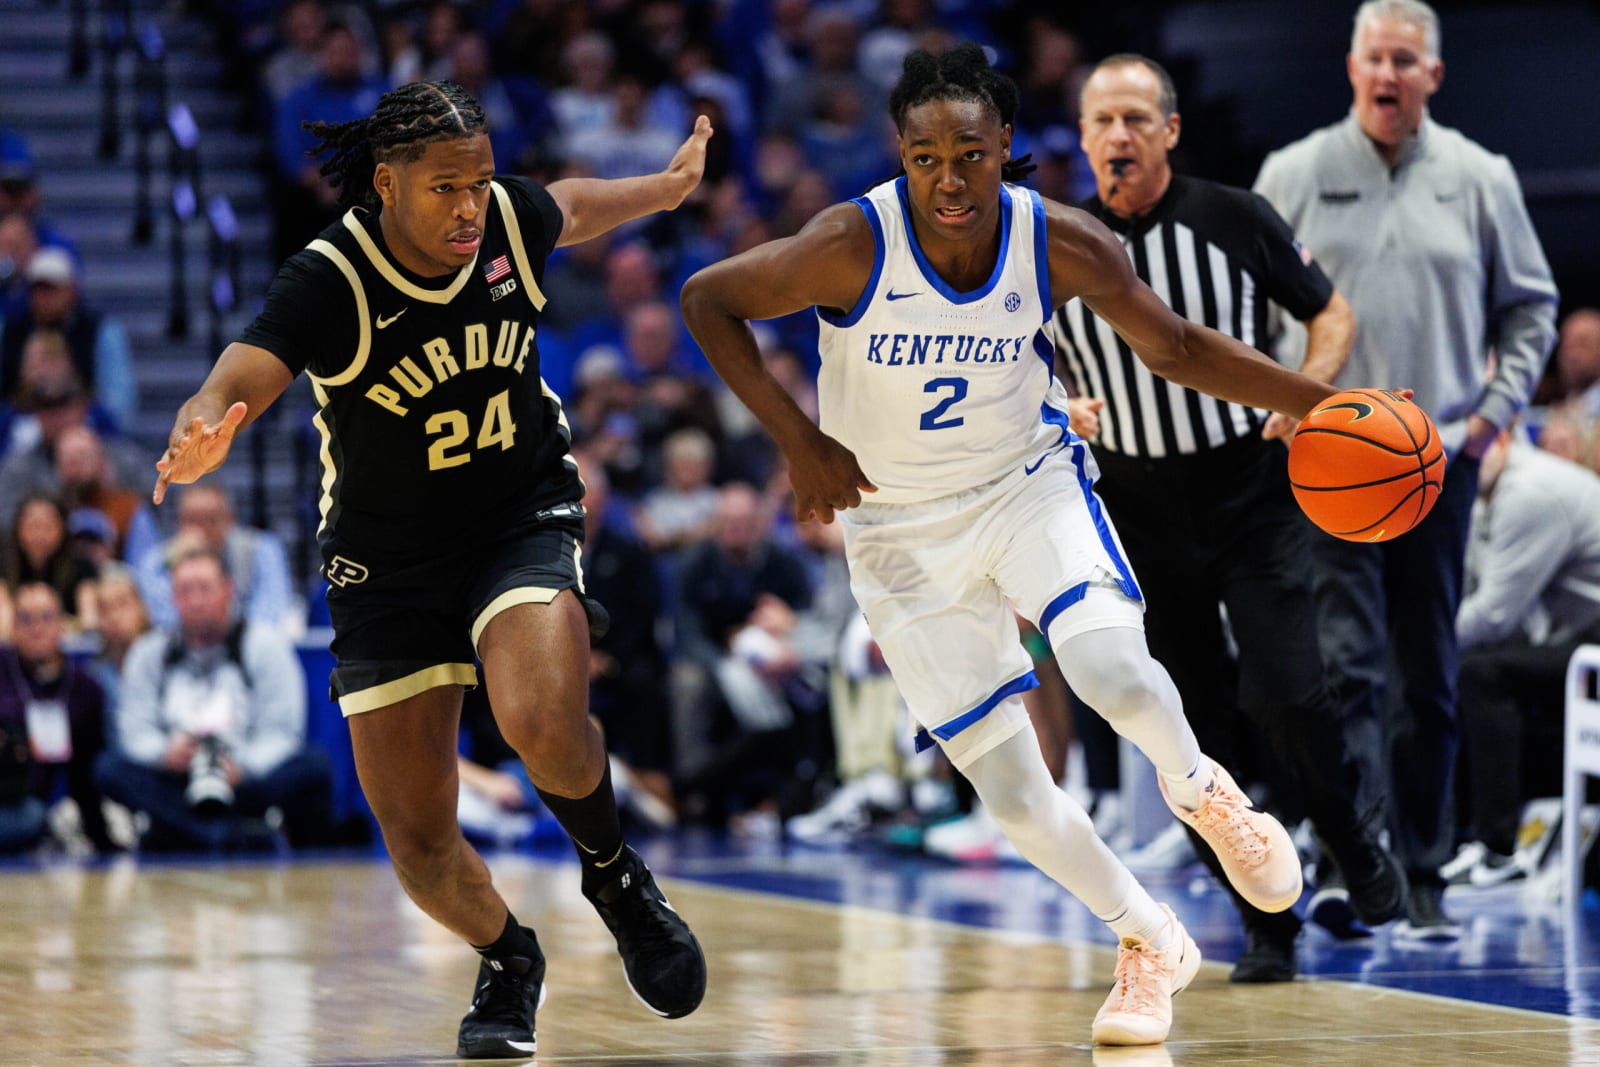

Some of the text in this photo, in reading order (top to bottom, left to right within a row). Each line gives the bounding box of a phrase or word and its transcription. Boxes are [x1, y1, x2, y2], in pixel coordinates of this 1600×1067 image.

[1005, 292, 1021, 312] SEC
[365, 320, 535, 417] PURDUE
[867, 333, 1028, 366] KENTUCKY
[919, 377, 969, 430] 2
[425, 389, 516, 471] 24
[328, 555, 368, 587] P
